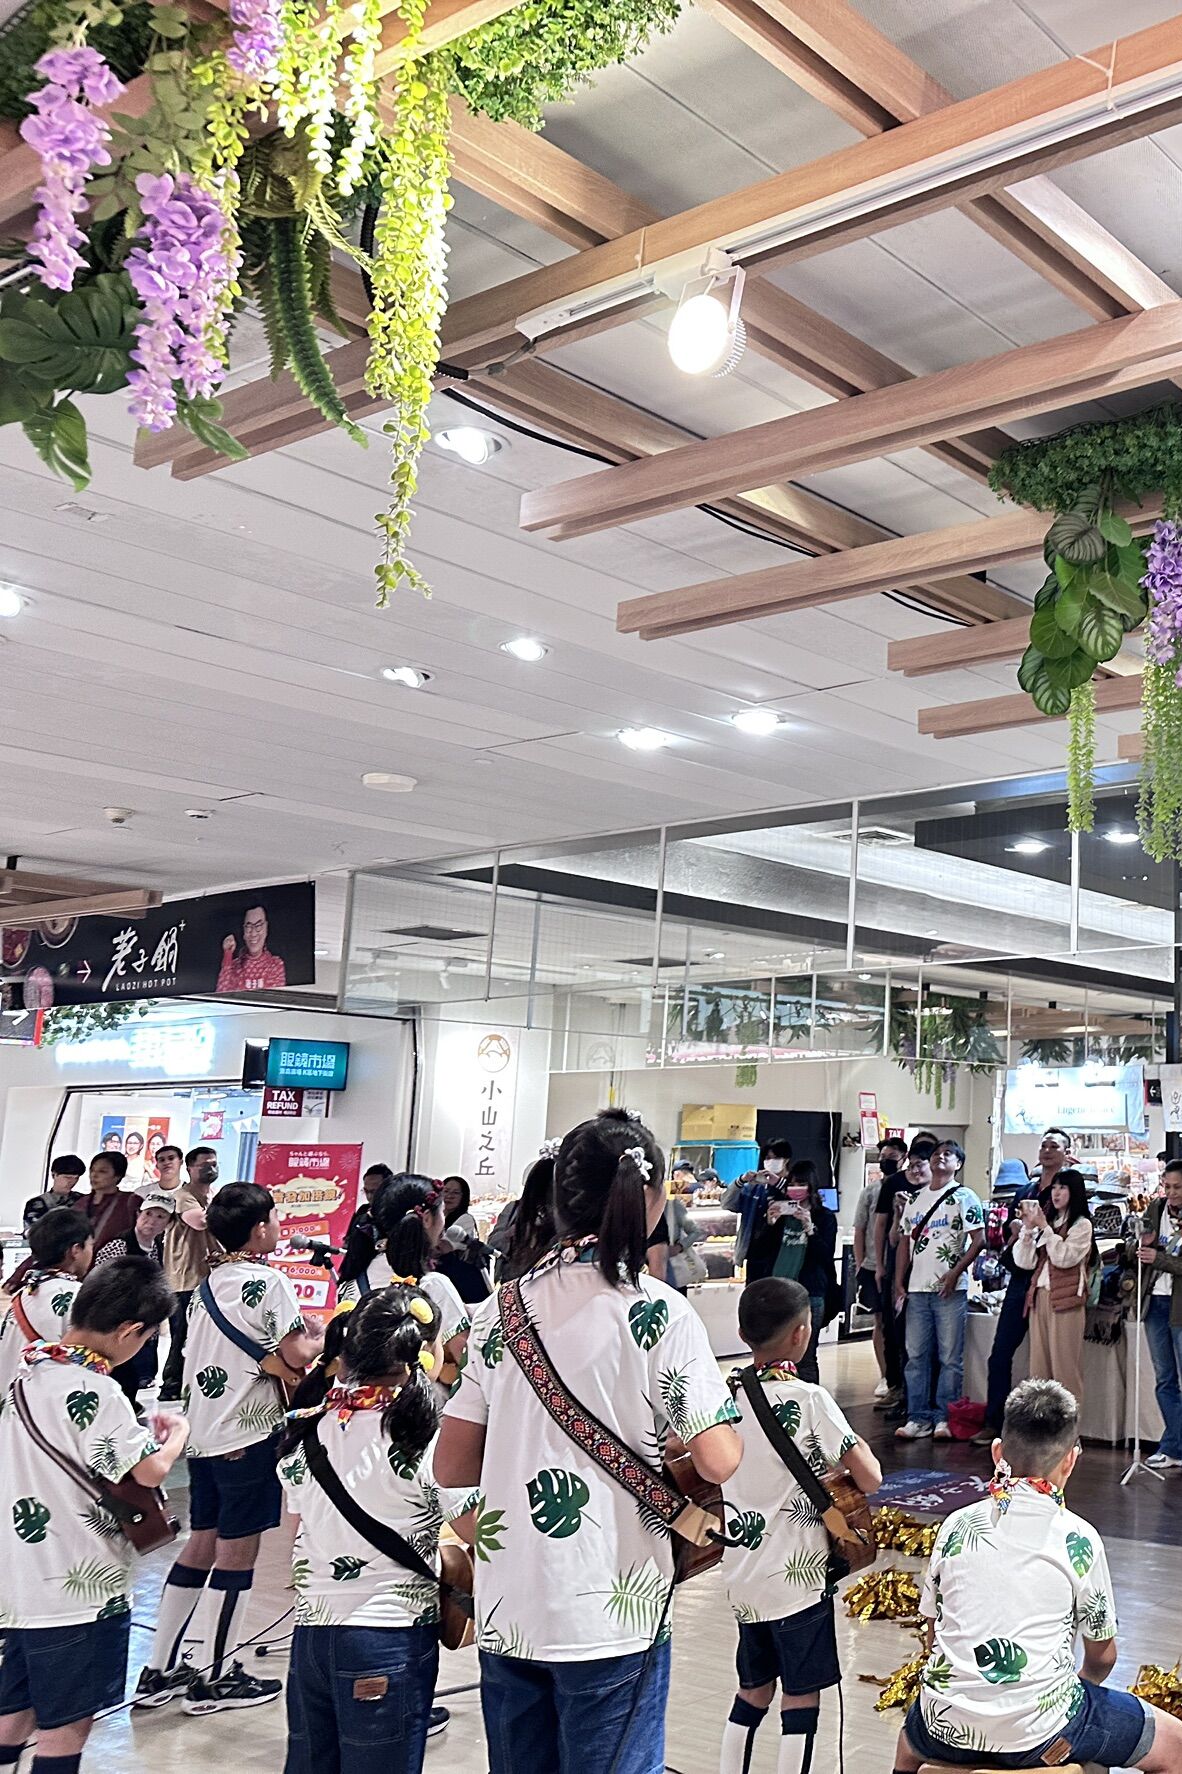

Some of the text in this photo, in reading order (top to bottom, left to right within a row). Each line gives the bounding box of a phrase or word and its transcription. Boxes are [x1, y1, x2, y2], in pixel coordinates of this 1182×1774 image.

[115, 977, 177, 992] LAOZI HOT POT
[272, 1090, 295, 1101] TAX
[266, 1101, 298, 1110] REFUND
[475, 1080, 502, 1176] 小山之丘
[888, 1129, 902, 1139] TAX
